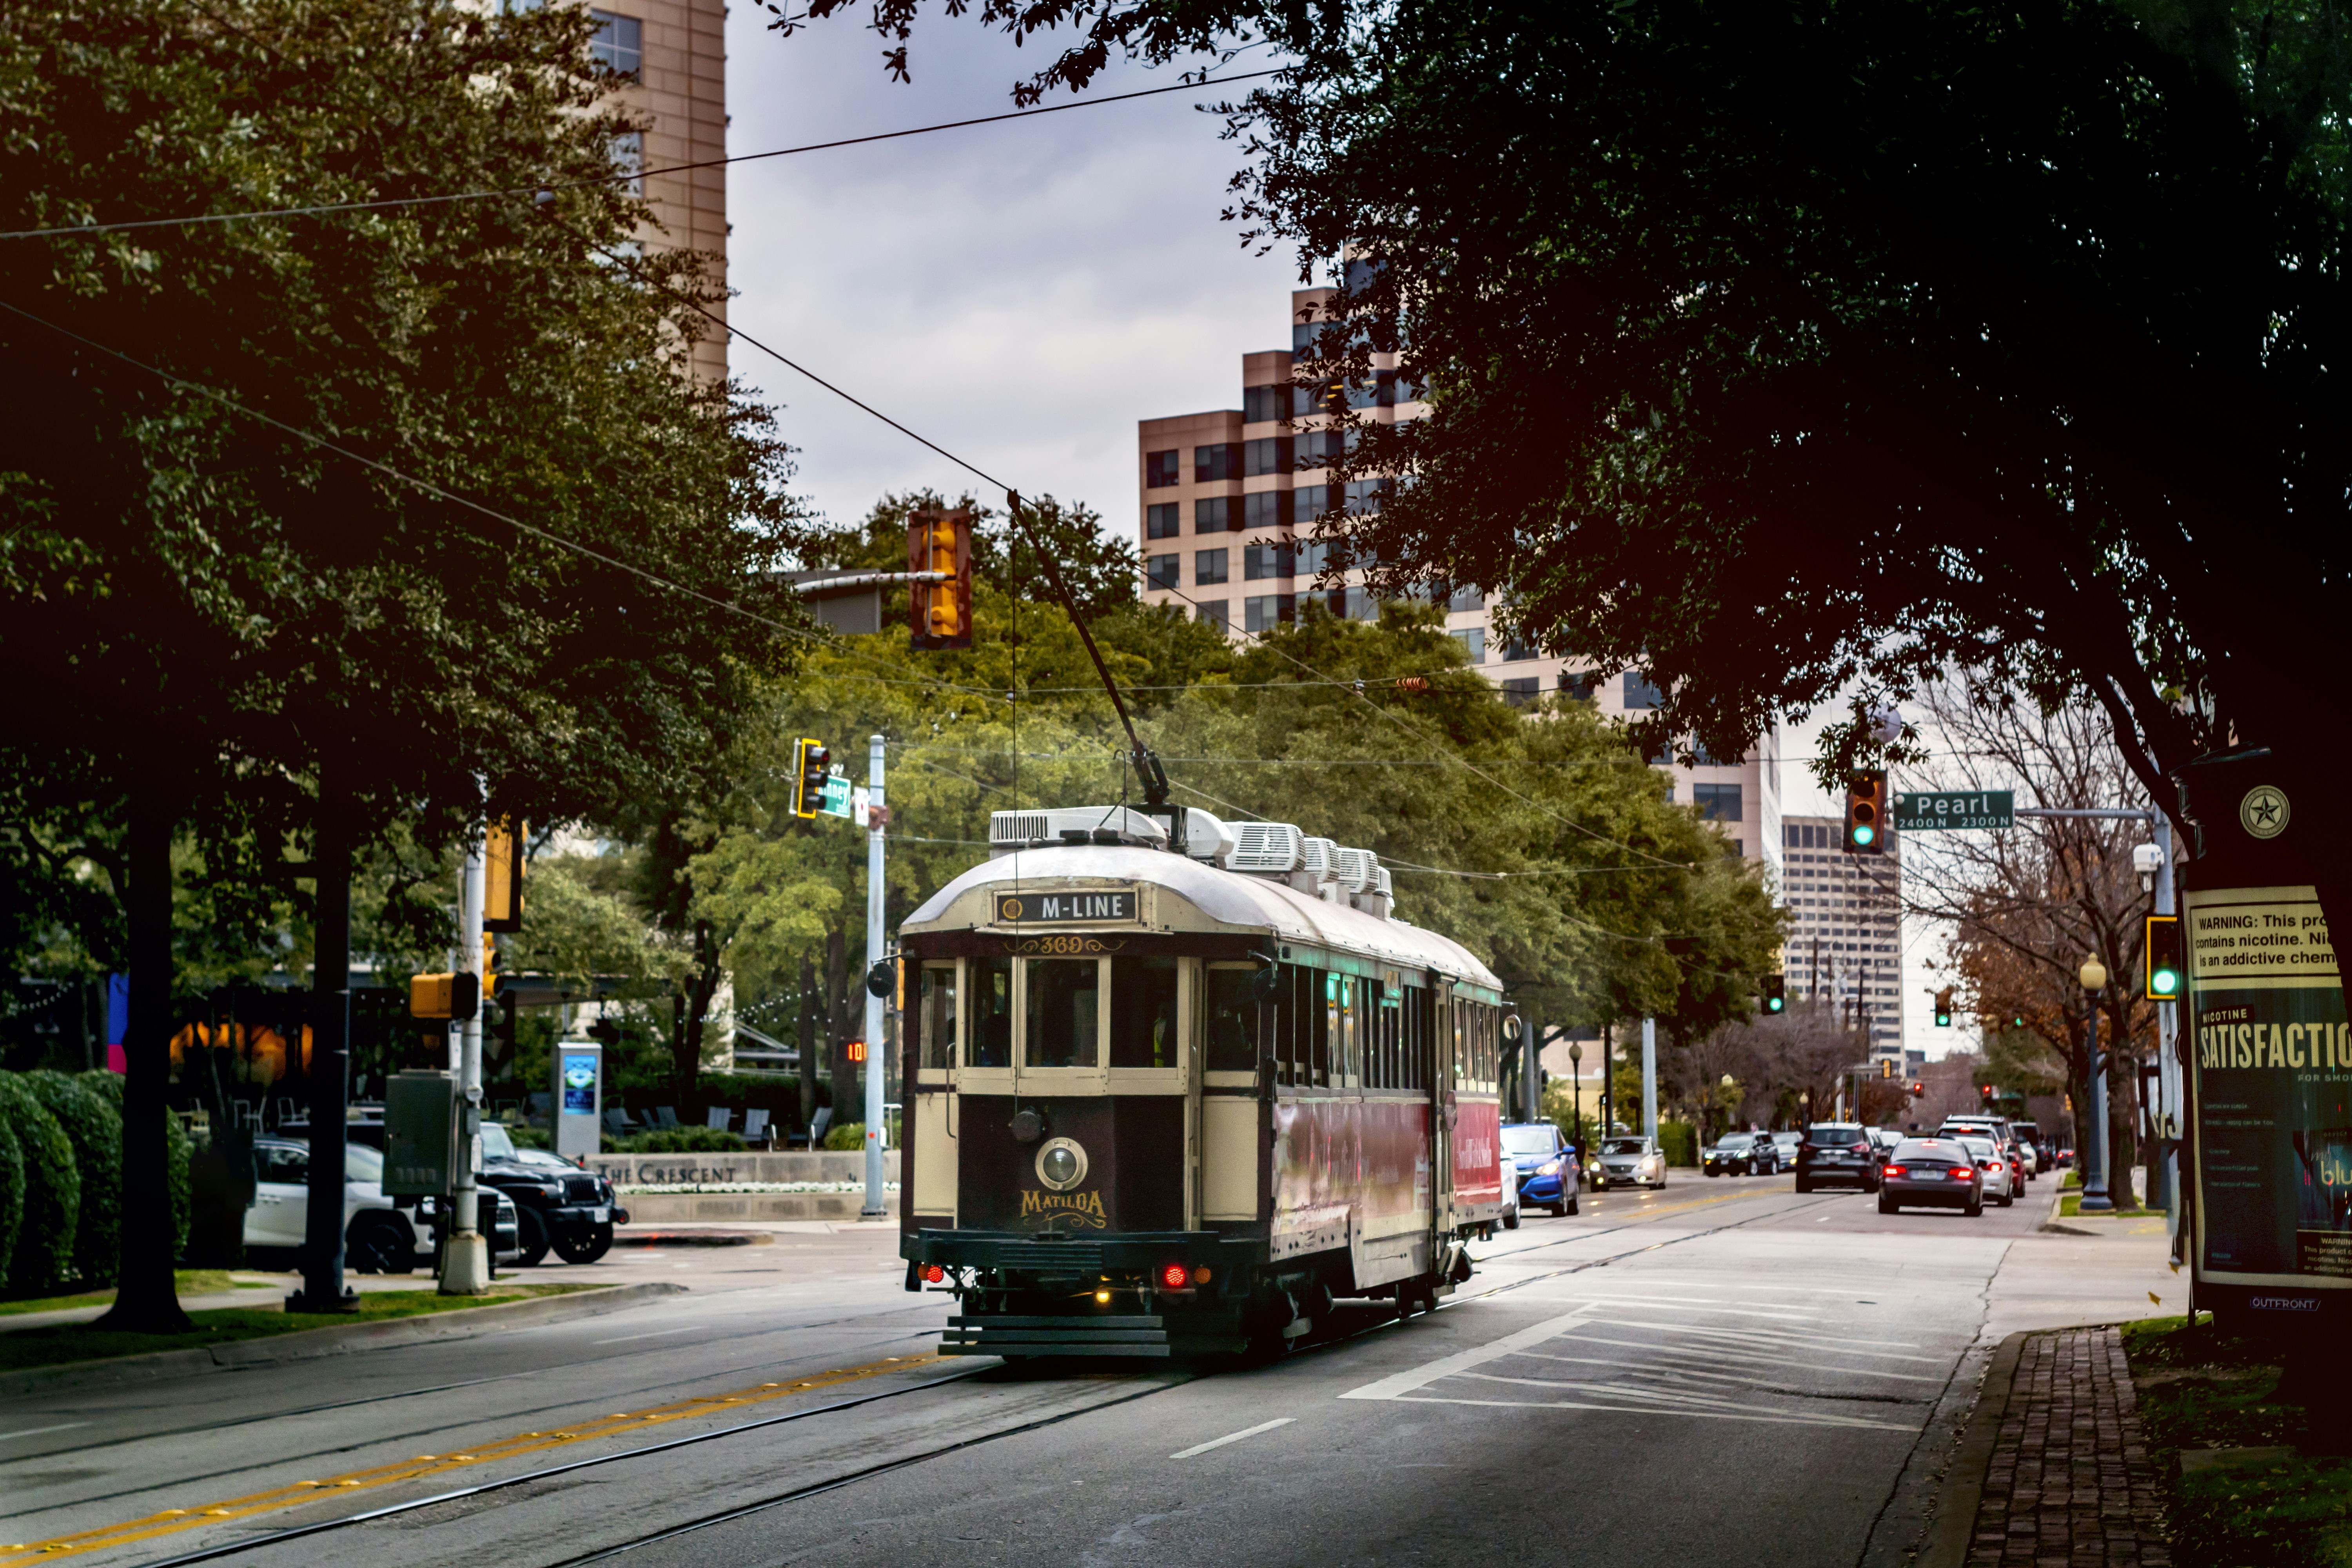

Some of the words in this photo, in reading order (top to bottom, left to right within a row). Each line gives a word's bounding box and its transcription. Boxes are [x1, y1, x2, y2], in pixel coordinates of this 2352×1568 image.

[1918, 794, 1989, 815] Pearl
[1899, 818, 1934, 828] 2400
[1938, 818, 1946, 827] N
[1962, 817, 1996, 827] 2300
[2000, 816, 2009, 826] N
[1042, 895, 1122, 918] M-LINE
[2200, 915, 2258, 931] WARNING:
[2263, 914, 2296, 928] This
[1040, 936, 1083, 953] 369
[2196, 934, 2235, 949] contains
[2239, 933, 2303, 947] nicotine.
[2200, 954, 2206, 967] is
[2209, 955, 2220, 966] an
[2223, 952, 2285, 966] addictive
[2290, 951, 2335, 963] chem
[2203, 1008, 2247, 1023] NICOTINE
[848, 1043, 862, 1062] 10
[2325, 1074, 2352, 1082] SMO
[598, 1164, 633, 1183] THE
[639, 1163, 736, 1183] CRESCENT
[2321, 1160, 2352, 1185] blu
[1021, 1190, 1106, 1218] MATILDA
[2314, 1265, 2345, 1273] addictive
[2252, 1298, 2315, 1309] OUTFRONT
